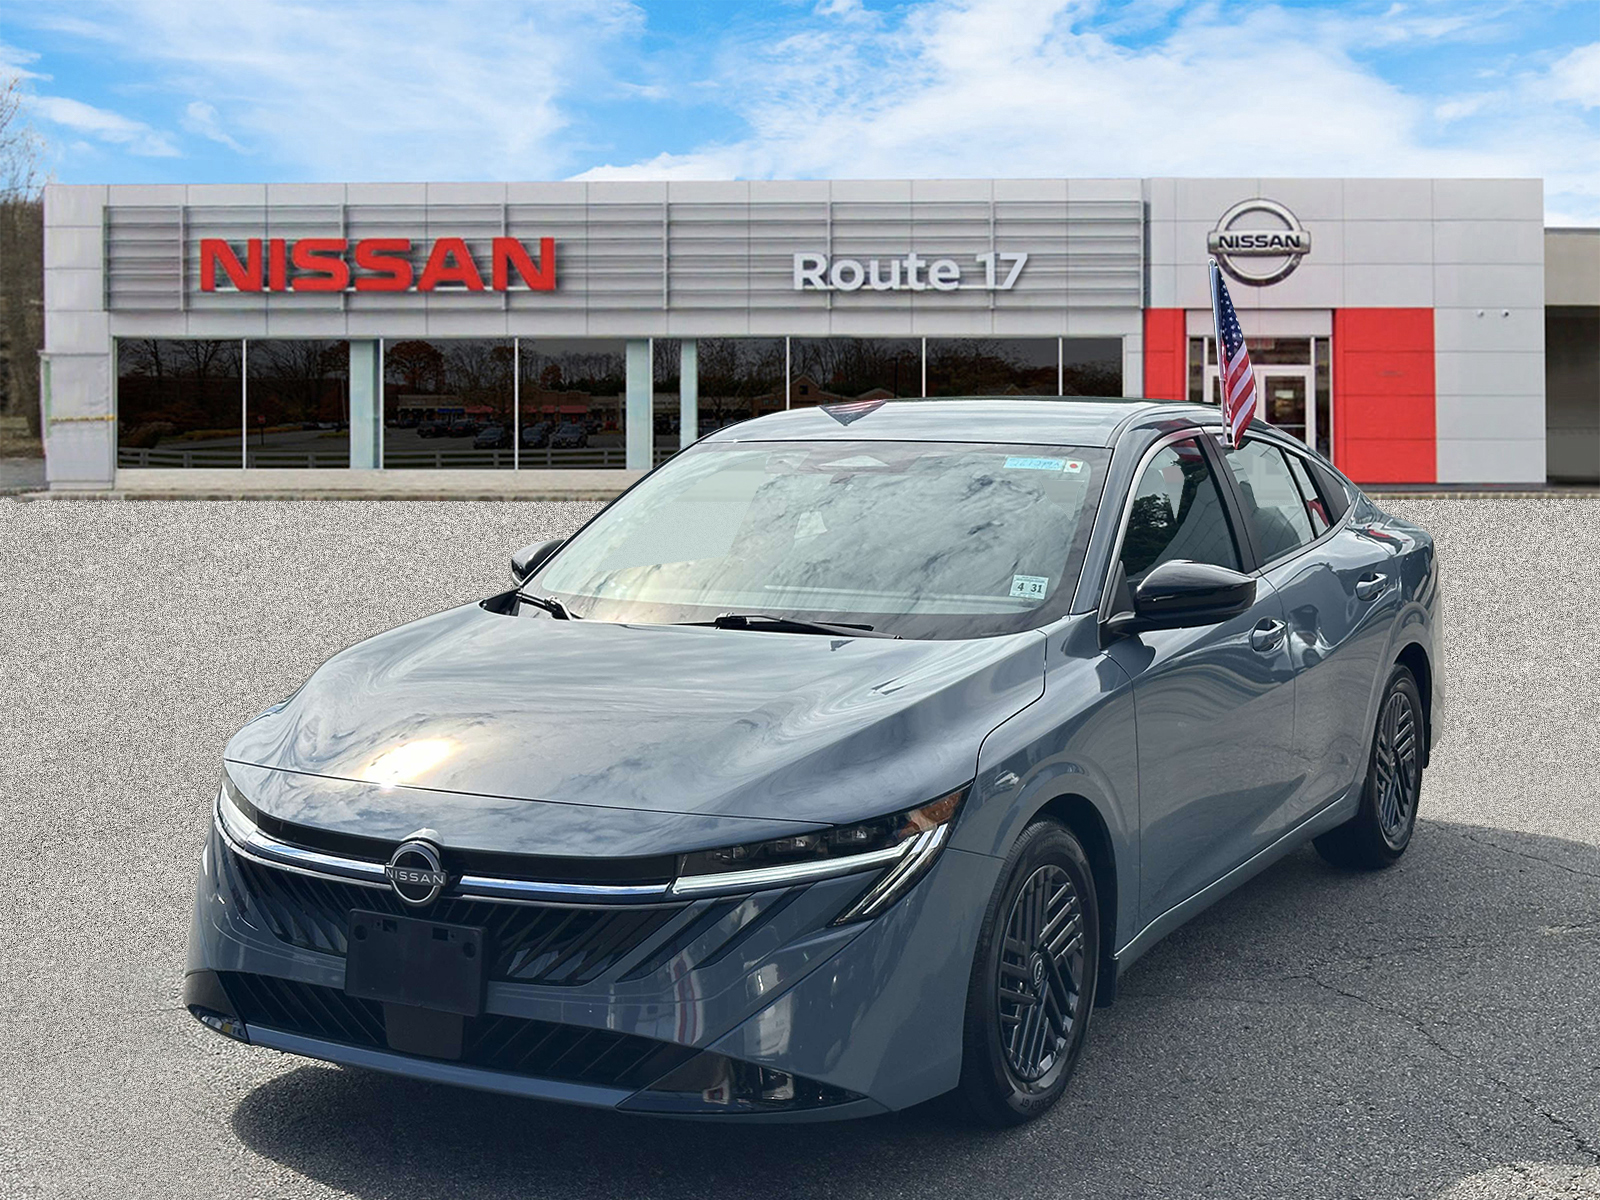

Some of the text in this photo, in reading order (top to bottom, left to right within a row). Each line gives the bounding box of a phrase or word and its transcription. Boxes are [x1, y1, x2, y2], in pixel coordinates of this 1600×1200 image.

[1218, 235, 1301, 249] NISSAN
[200, 237, 556, 292] NISSAN
[793, 252, 1028, 291] Route 17
[1017, 582, 1043, 593] 4 31
[385, 868, 444, 884] NISSAN
